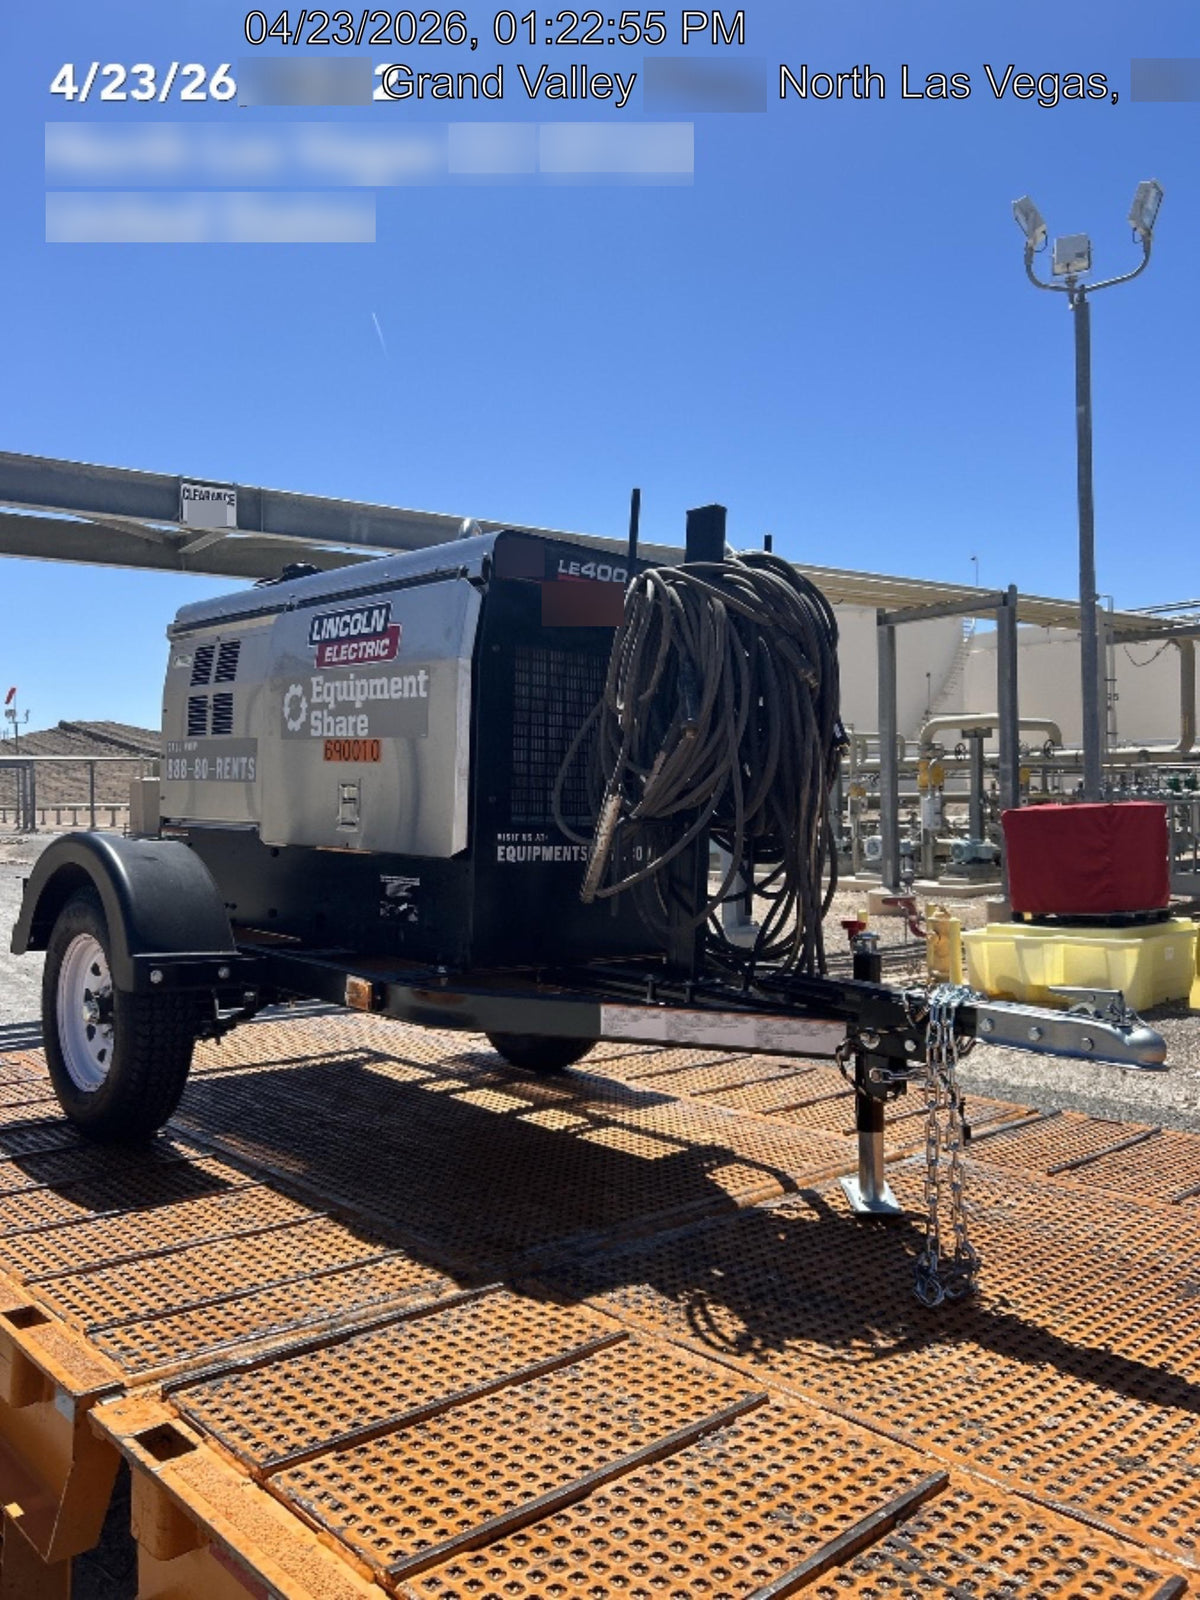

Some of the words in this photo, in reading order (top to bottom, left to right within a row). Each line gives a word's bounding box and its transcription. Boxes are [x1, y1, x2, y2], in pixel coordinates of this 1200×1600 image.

[558, 559, 628, 583] LE400
[312, 608, 386, 641] LINCOLN
[324, 638, 390, 662] ELECTRIC
[310, 669, 429, 710] Equipment
[310, 709, 368, 737] Share
[324, 739, 380, 761] 690010
